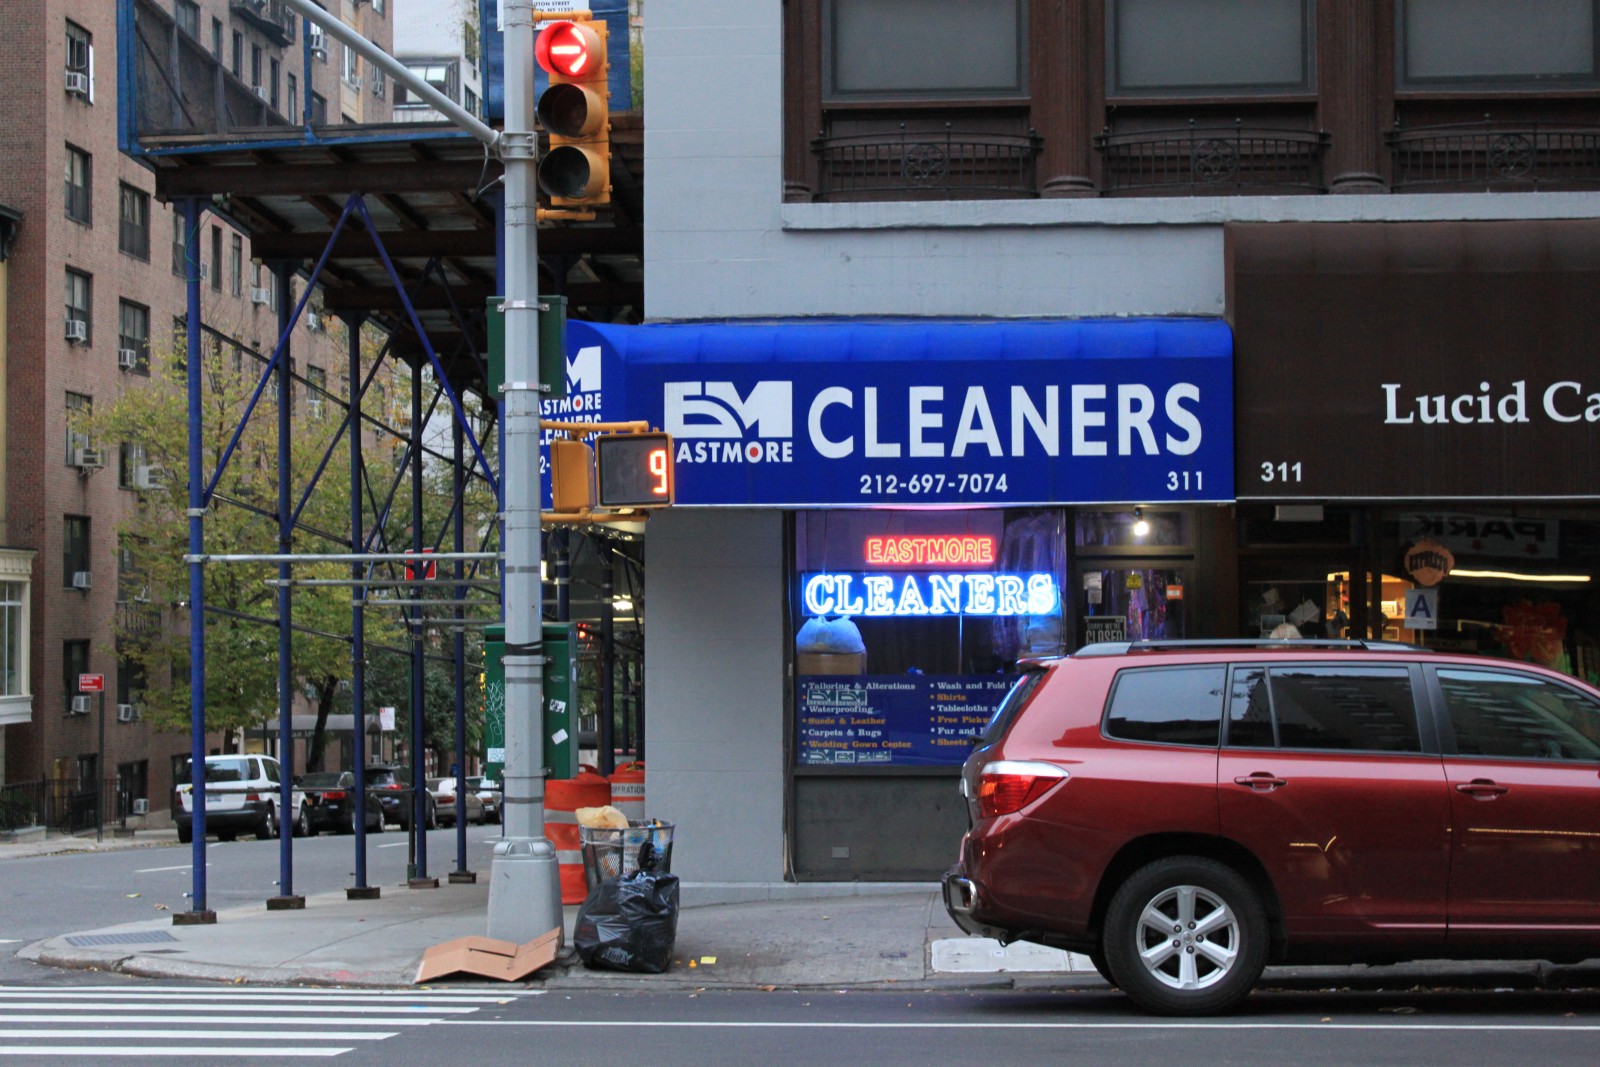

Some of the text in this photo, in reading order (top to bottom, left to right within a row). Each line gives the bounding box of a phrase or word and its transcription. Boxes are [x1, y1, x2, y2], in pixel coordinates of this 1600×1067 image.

[1381, 380, 1530, 425] Lucid
[807, 382, 1202, 459] CLEANERS
[672, 441, 793, 463] ASTMORE
[649, 449, 668, 495] 9
[1260, 461, 1302, 482] 311
[859, 473, 1008, 494] 212-697-7074
[1166, 471, 1203, 491] 311
[866, 537, 994, 564] EASTMORE
[804, 573, 1057, 617] CLEANERS
[1410, 594, 1432, 618] A
[808, 682, 850, 691] Tailoring
[866, 682, 916, 690] Alterations
[937, 681, 962, 690] Wash
[965, 682, 983, 690] and
[986, 681, 1006, 690] Fold
[937, 693, 966, 701] Shirts
[809, 705, 874, 714] Waterproofing
[937, 704, 988, 712] Tablecloths
[808, 717, 835, 725] Suede
[851, 717, 886, 725] Leather
[937, 716, 958, 724] Free
[808, 729, 843, 738] Carpets
[858, 729, 882, 738] Rugs
[937, 727, 956, 735] Fur
[958, 727, 976, 735] and
[809, 740, 912, 750] Wedding Gown Center
